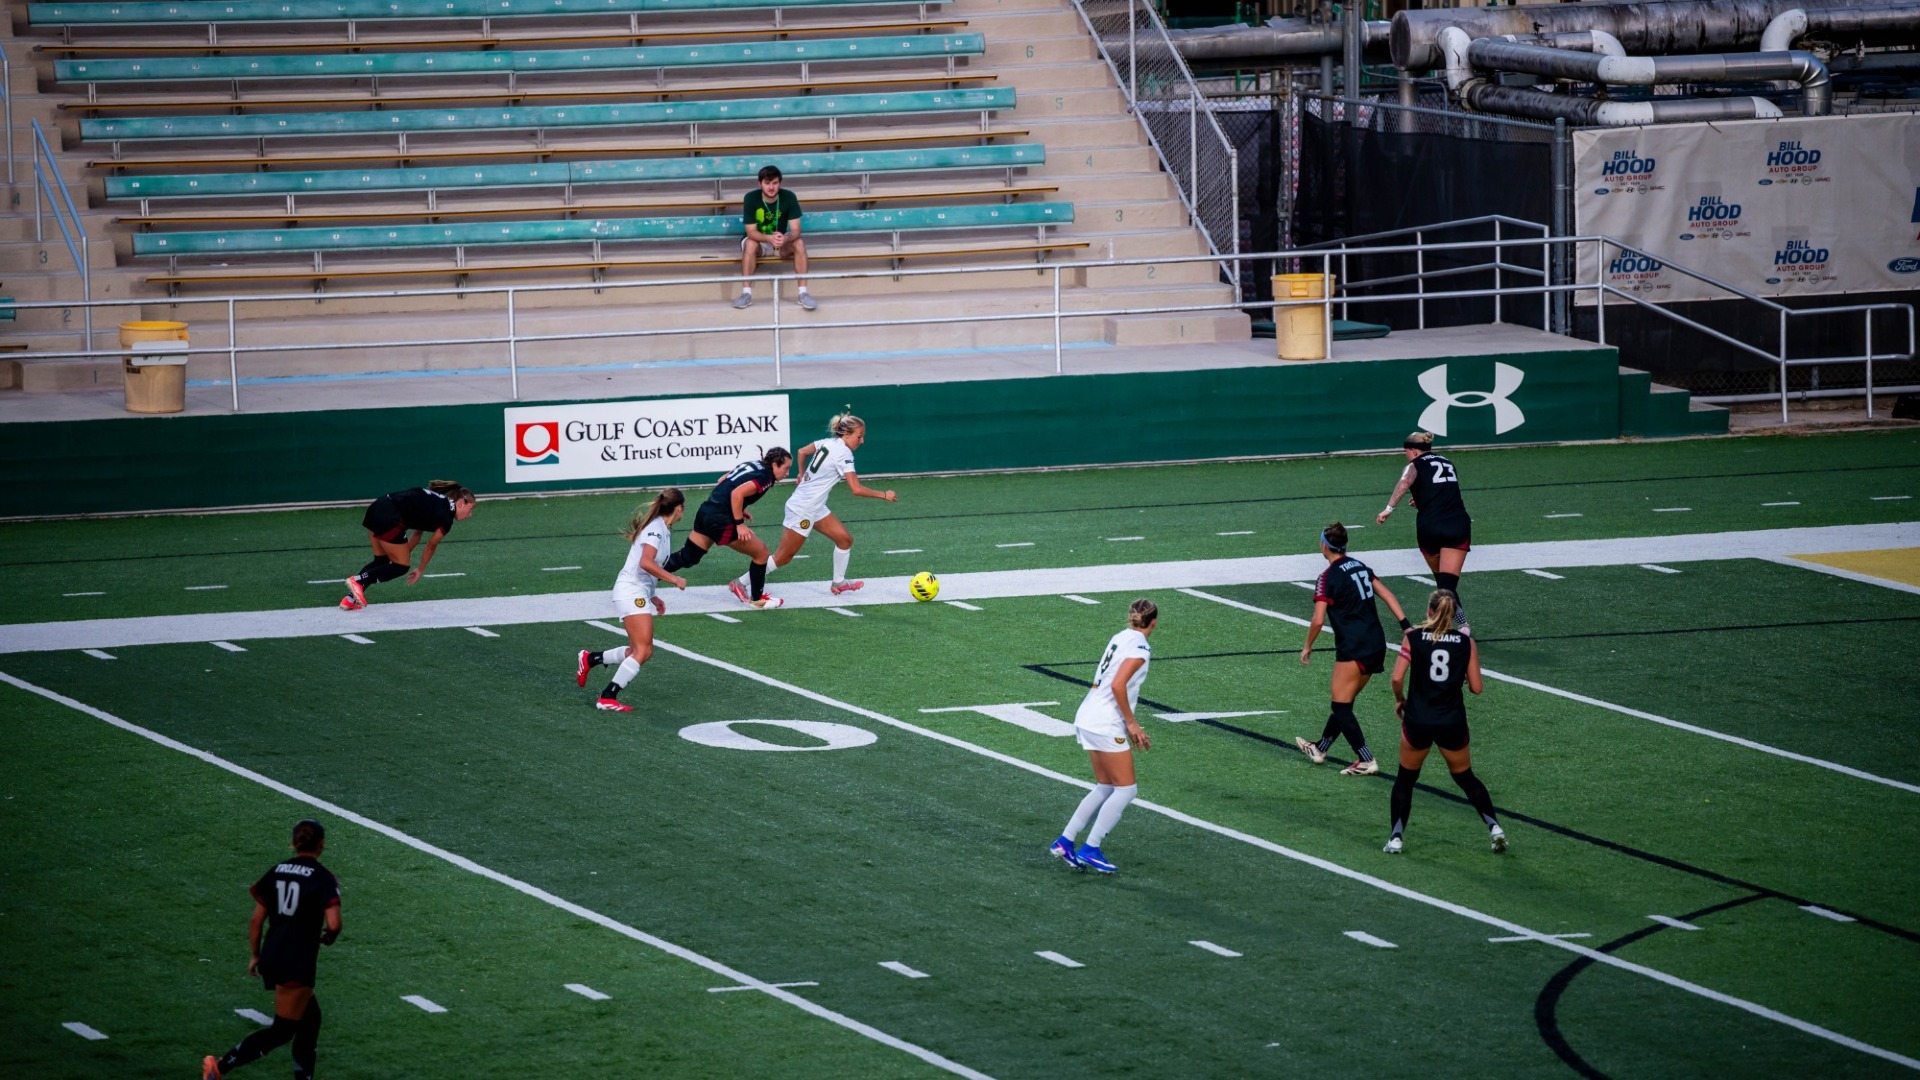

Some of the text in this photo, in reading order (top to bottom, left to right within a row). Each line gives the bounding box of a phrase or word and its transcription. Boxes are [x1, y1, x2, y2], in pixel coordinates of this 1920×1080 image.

[1026, 45, 1034, 58] 6
[1779, 141, 1803, 152] BILL
[1613, 150, 1638, 160] BILL
[1767, 150, 1822, 166] HOOD
[1602, 158, 1656, 176] HOOD
[1700, 196, 1723, 206] BILL
[1115, 209, 1123, 222] 3
[1688, 204, 1742, 221] HOOD
[1786, 240, 1811, 250] BILL
[39, 251, 48, 264] 3
[1774, 248, 1829, 265] HOOD
[1147, 265, 1155, 279] 2
[1894, 259, 1919, 271] Ford
[63, 309, 72, 322] 2
[565, 413, 779, 442] GULF COAST BANK
[600, 442, 743, 461] & Trust Company
[1430, 461, 1457, 483] 23
[1350, 570, 1374, 600] 13
[1421, 632, 1462, 643] TRJANS
[1429, 649, 1450, 682] 8
[275, 863, 315, 877] TROJANS
[276, 880, 300, 916] 10
